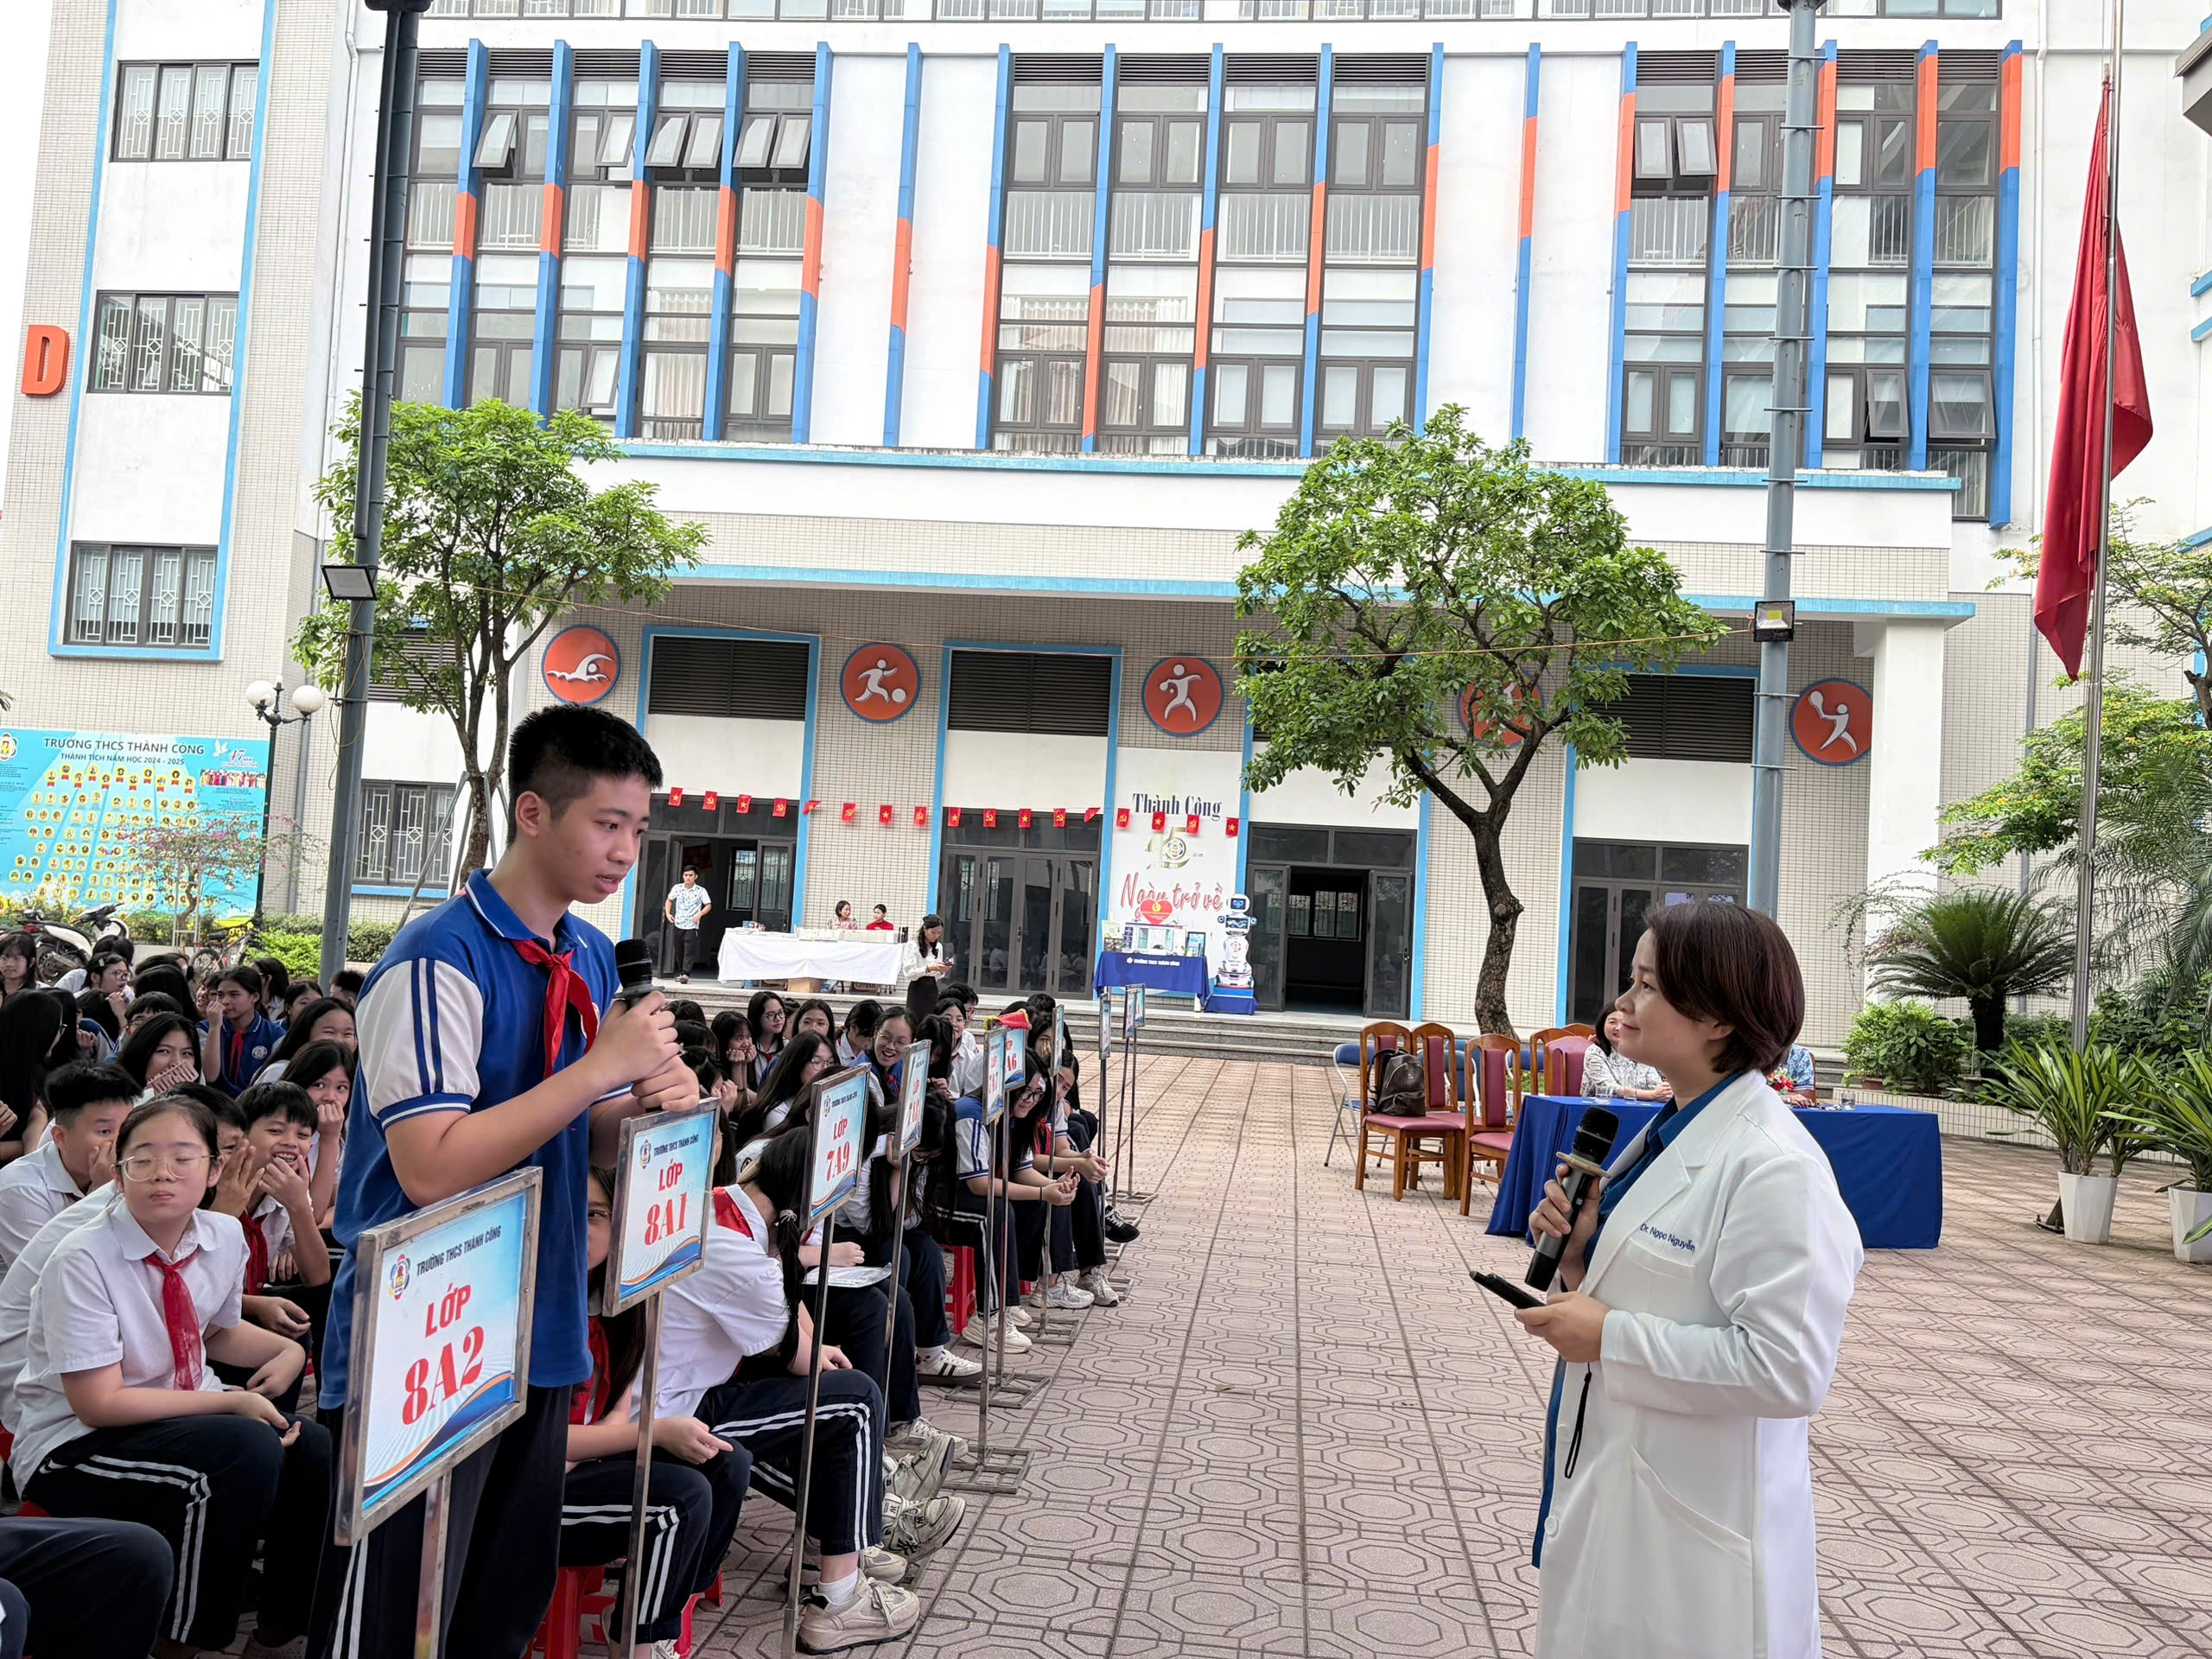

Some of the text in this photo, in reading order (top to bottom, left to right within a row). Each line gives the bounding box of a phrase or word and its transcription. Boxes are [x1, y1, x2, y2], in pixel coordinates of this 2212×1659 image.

[21, 325, 70, 396] D
[44, 737, 204, 754] TRƯỜNG THCS THÀNH CÔNG
[1133, 793, 1223, 822] Thành Công
[1173, 881, 1201, 911] trở
[1202, 881, 1224, 912] về
[833, 1115, 848, 1141] LỚP
[658, 1158, 683, 1192] LỚP
[827, 1141, 850, 1182] 7A9
[645, 1192, 687, 1246] 8A1
[416, 1253, 444, 1277] TRƯỜNG
[446, 1243, 463, 1262] THCS
[464, 1233, 484, 1254] THÀNH
[485, 1225, 501, 1243] CÔNG
[1649, 1226, 1668, 1240] Ngọc
[1668, 1233, 1695, 1253] Nguyễn
[425, 1282, 472, 1338] LỚP
[402, 1325, 485, 1426] 8A2
